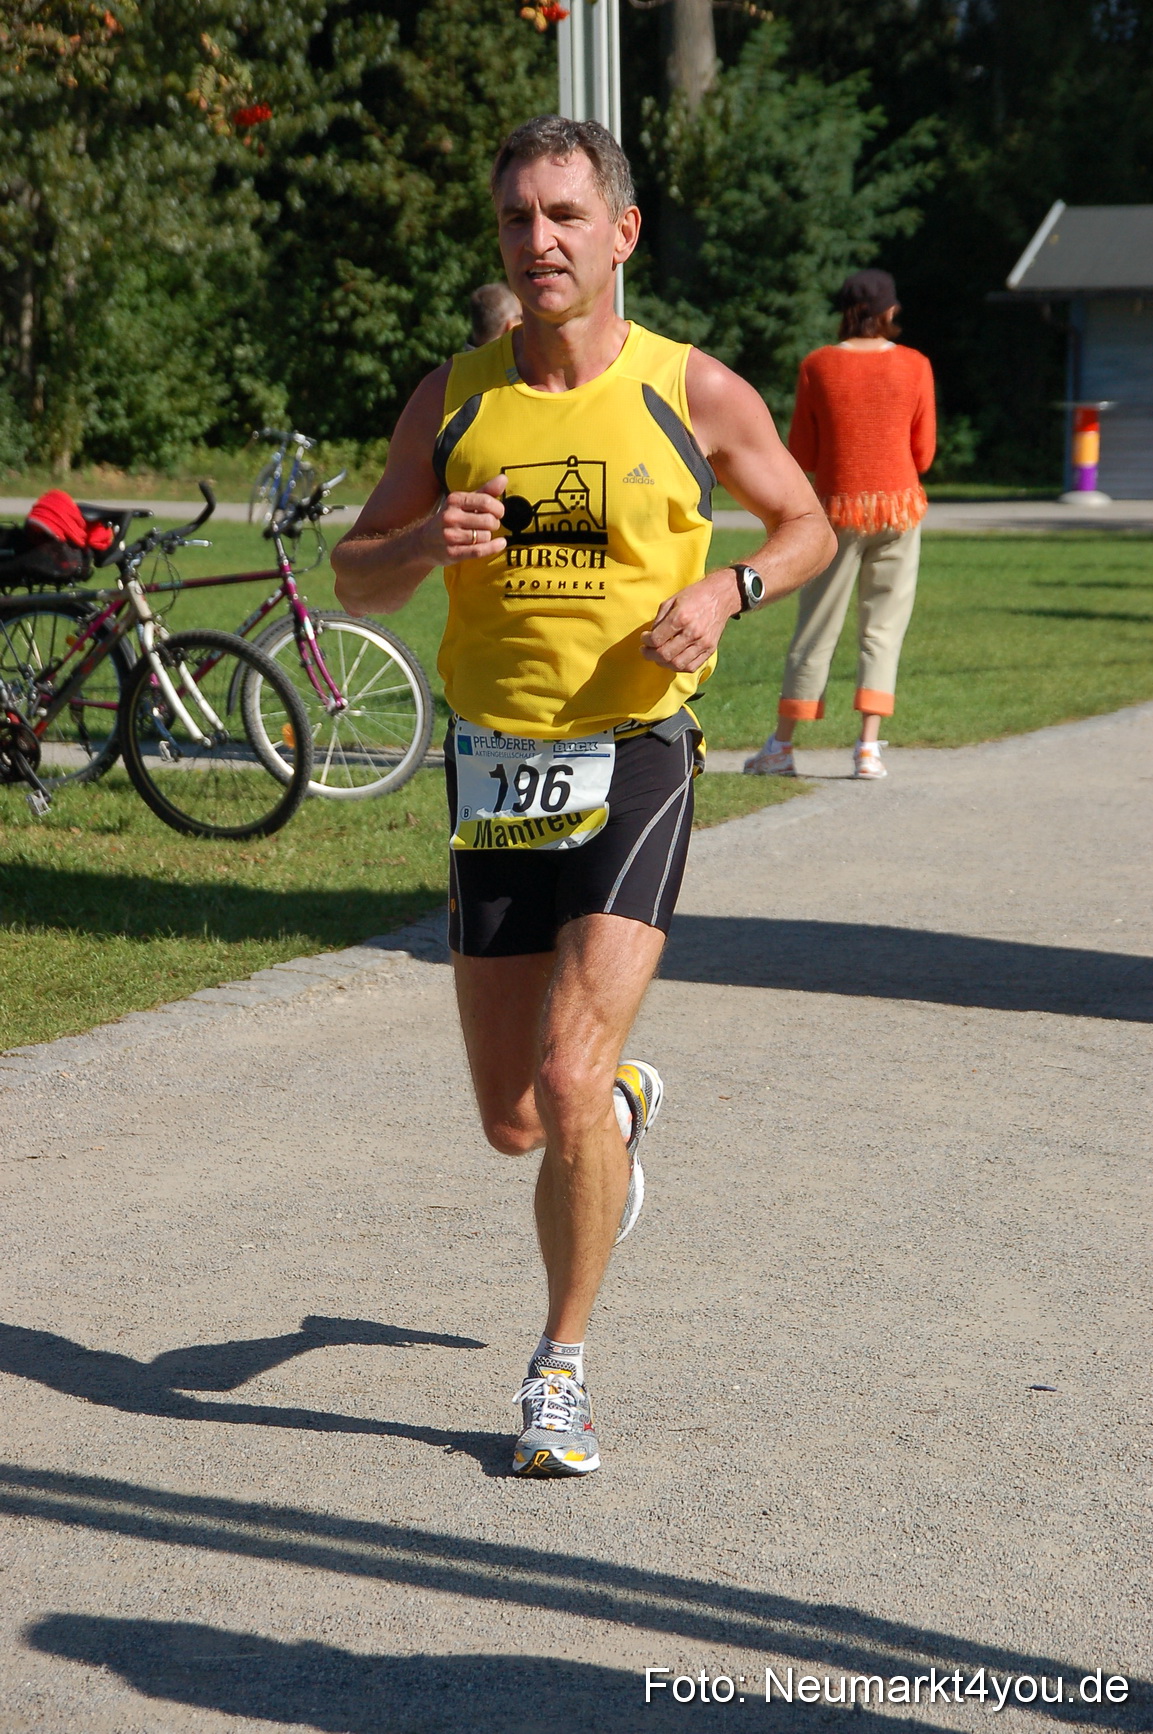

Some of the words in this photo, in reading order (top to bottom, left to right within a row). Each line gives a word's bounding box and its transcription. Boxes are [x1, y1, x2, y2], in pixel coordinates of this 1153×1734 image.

[622, 476, 655, 485] adidas
[507, 548, 607, 569] HIRSCH
[505, 580, 606, 590] APOTHEKE
[489, 763, 574, 813] 196
